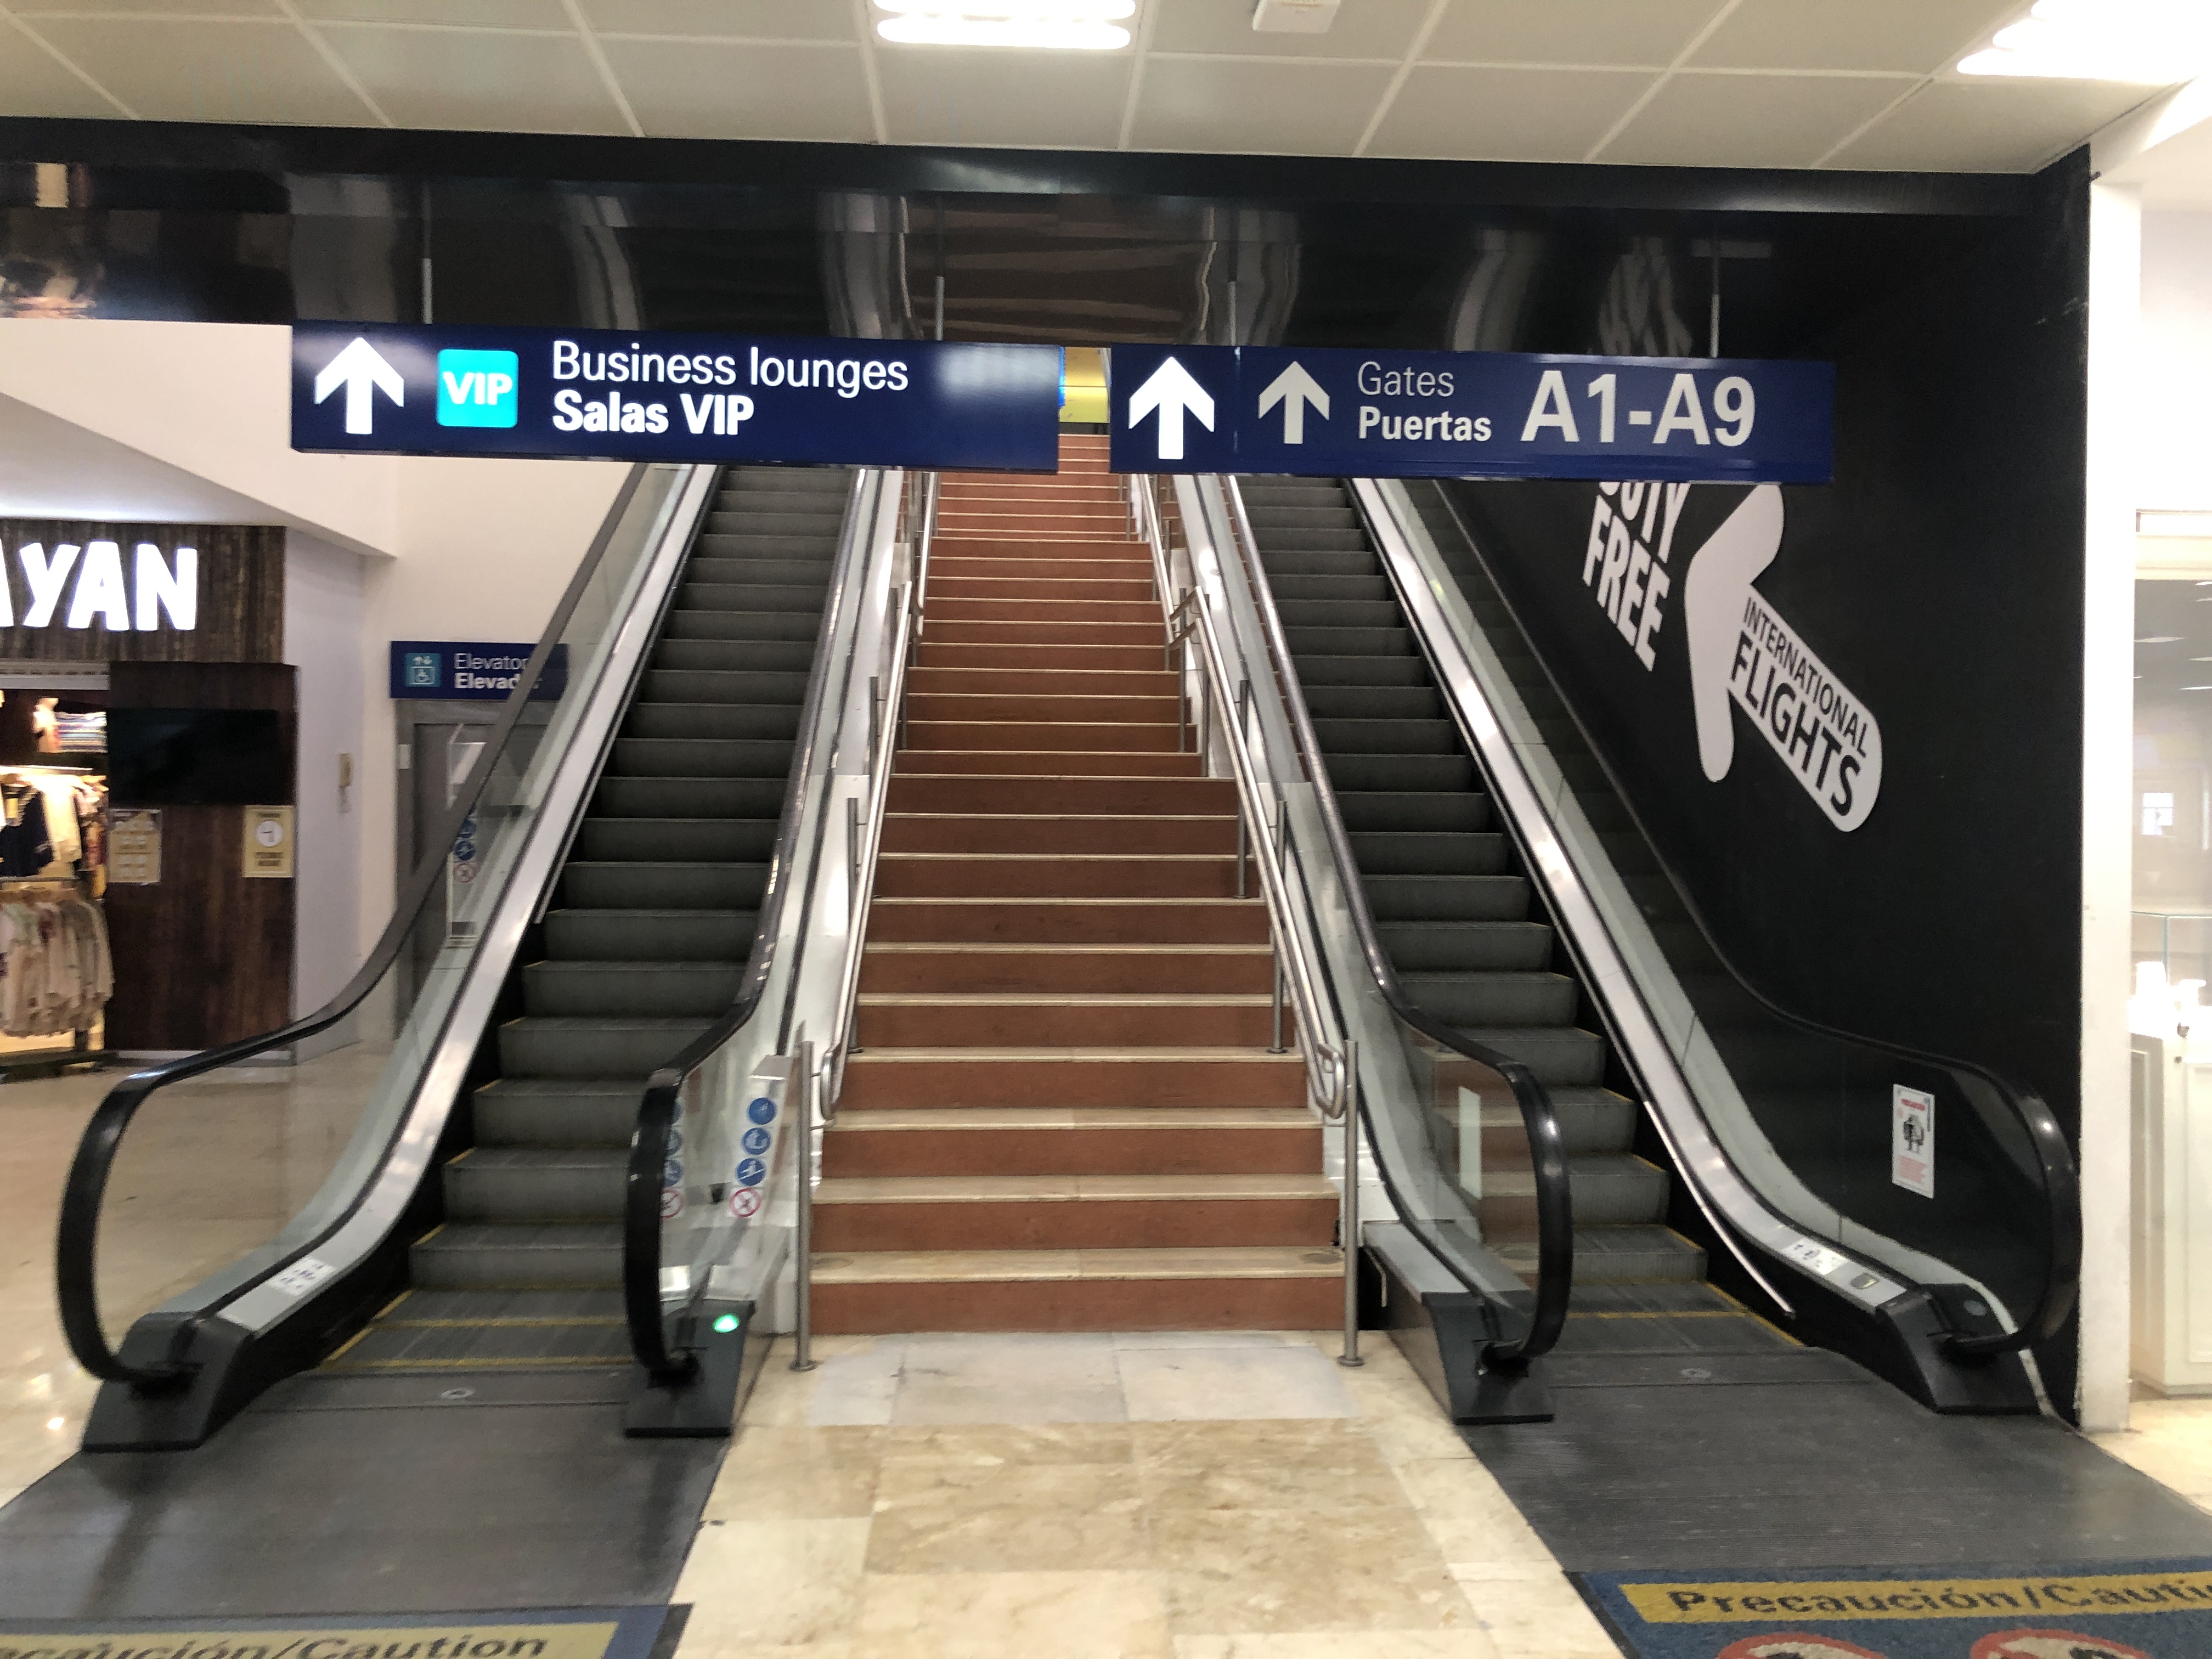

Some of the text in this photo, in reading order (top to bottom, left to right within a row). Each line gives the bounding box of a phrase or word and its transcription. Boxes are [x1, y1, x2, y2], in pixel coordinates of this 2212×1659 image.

[443, 371, 513, 405] VIP
[552, 340, 909, 398] Business lounges
[1358, 360, 1455, 398] Gates
[551, 389, 755, 435] Salas VIP
[1358, 405, 1492, 442] Puertas
[1520, 370, 1756, 447] A1-A9
[1599, 481, 1691, 563] UTY
[0, 538, 198, 631] YAN
[1582, 494, 1671, 672] FREE
[454, 673, 543, 689] Elevad
[1743, 597, 1868, 758] INTERNATIONAL
[1729, 630, 1861, 817] FLIGHTS
[1668, 1579, 2212, 1614] Precaución/Cauti
